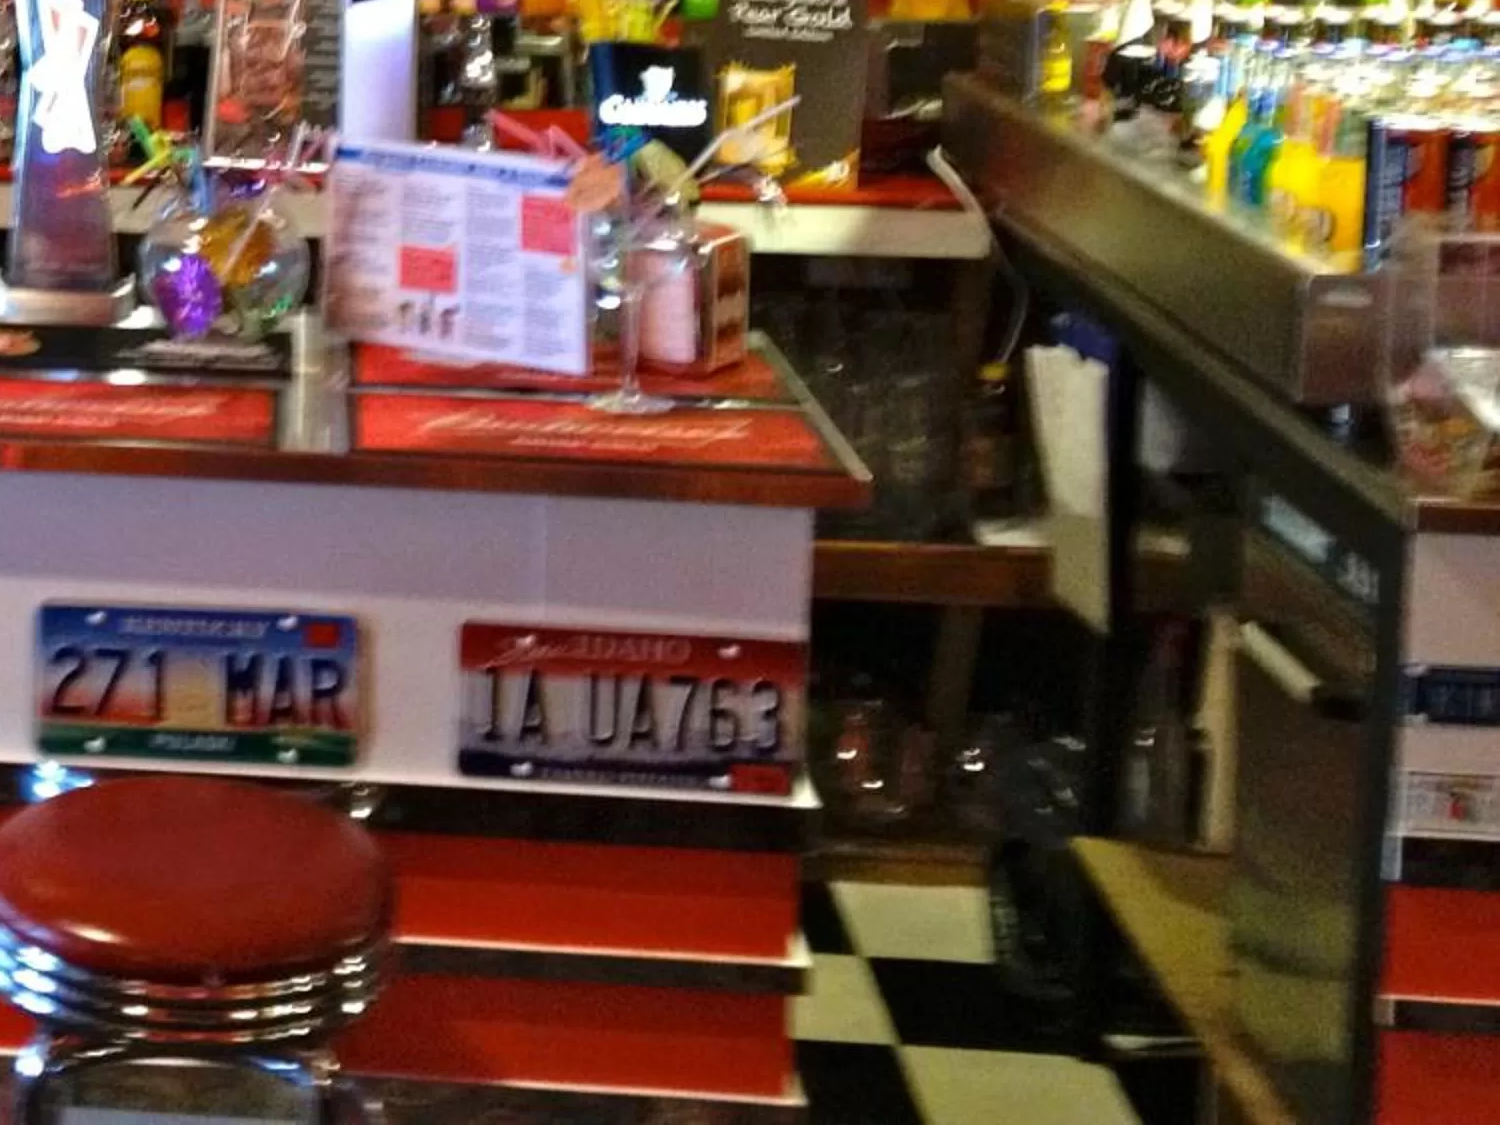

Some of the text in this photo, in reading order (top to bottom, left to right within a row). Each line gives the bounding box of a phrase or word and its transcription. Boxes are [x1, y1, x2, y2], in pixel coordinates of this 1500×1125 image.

[45, 645, 353, 730] 271 MAR
[572, 633, 693, 665] IDAHO
[584, 673, 782, 754] UA763
